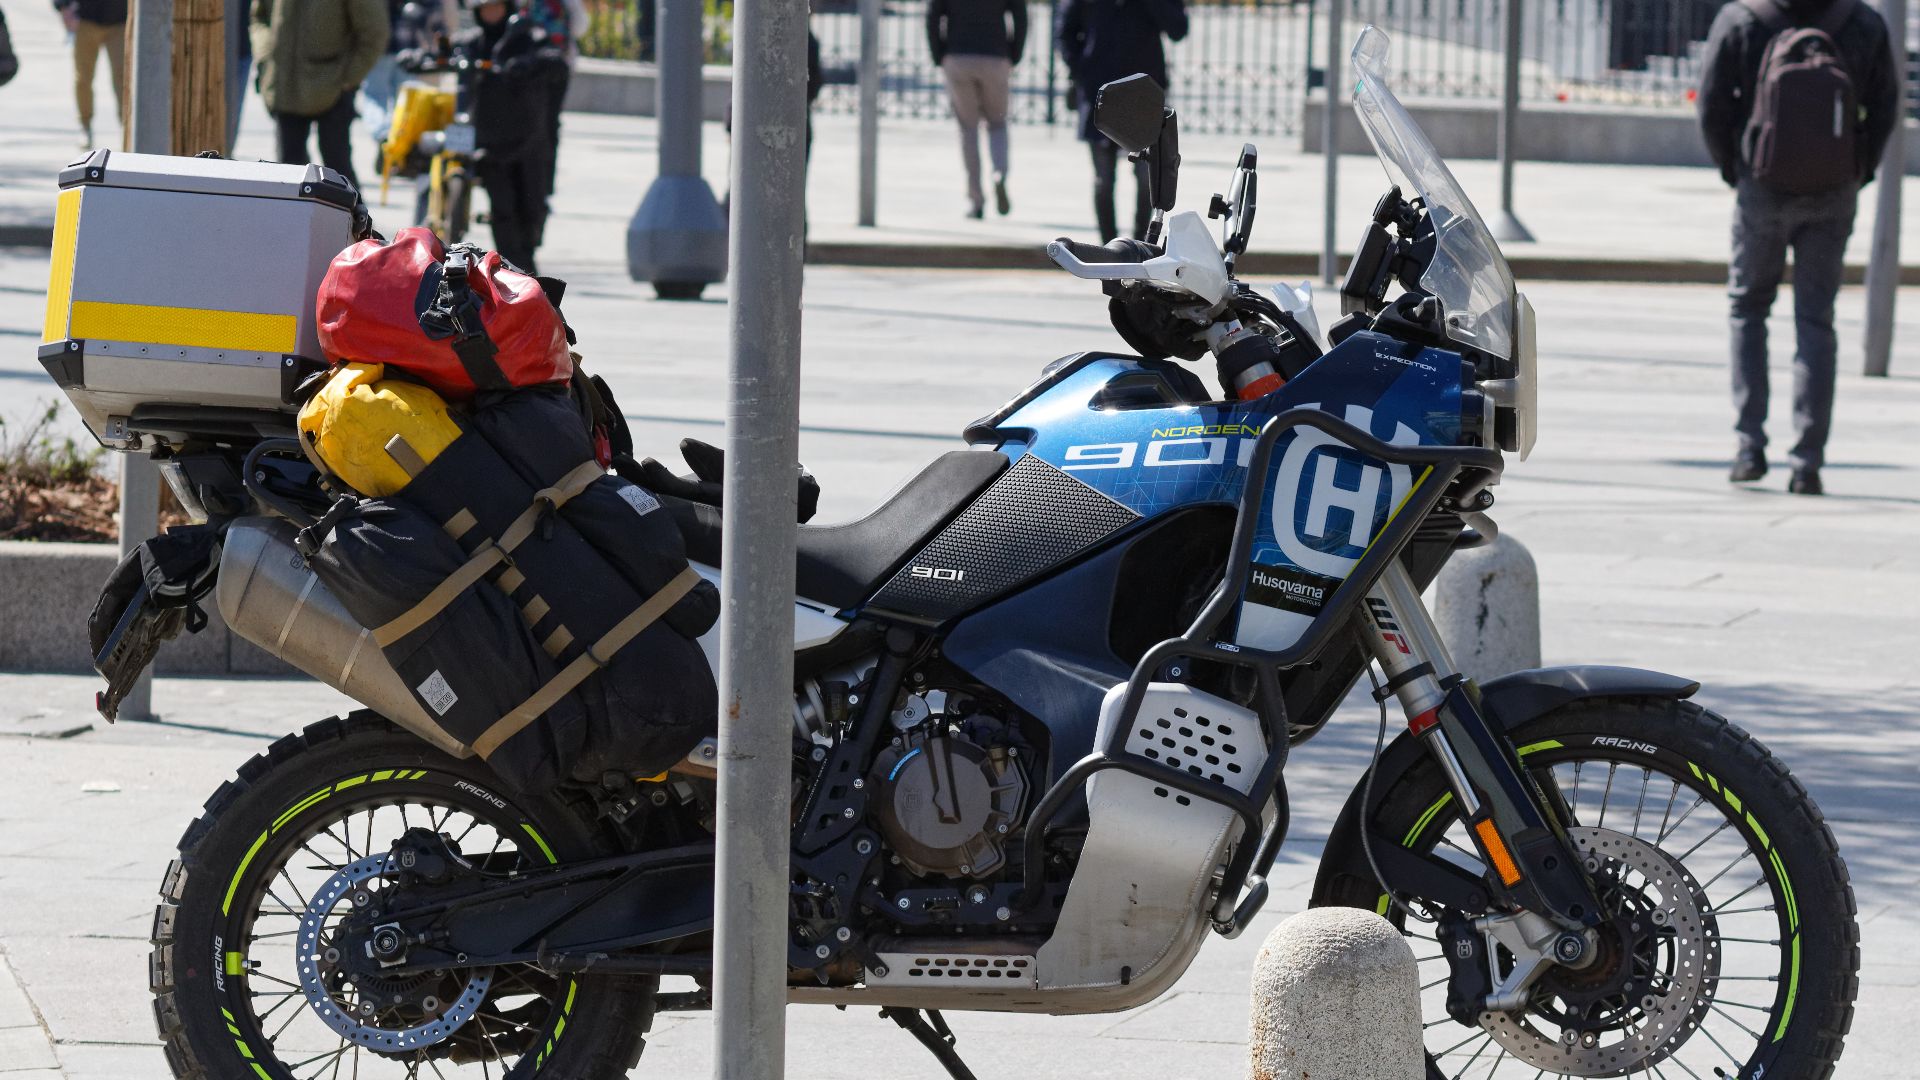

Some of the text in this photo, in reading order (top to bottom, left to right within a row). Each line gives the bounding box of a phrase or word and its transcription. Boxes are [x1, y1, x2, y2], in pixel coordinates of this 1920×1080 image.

[1375, 352, 1437, 372] EXPEDITION
[1151, 424, 1261, 438] NORDEN
[911, 566, 964, 581] 901
[1252, 570, 1324, 600] Husqvarna
[1591, 736, 1658, 754] RACING
[453, 780, 507, 809] RACING
[214, 935, 226, 993] RACING
